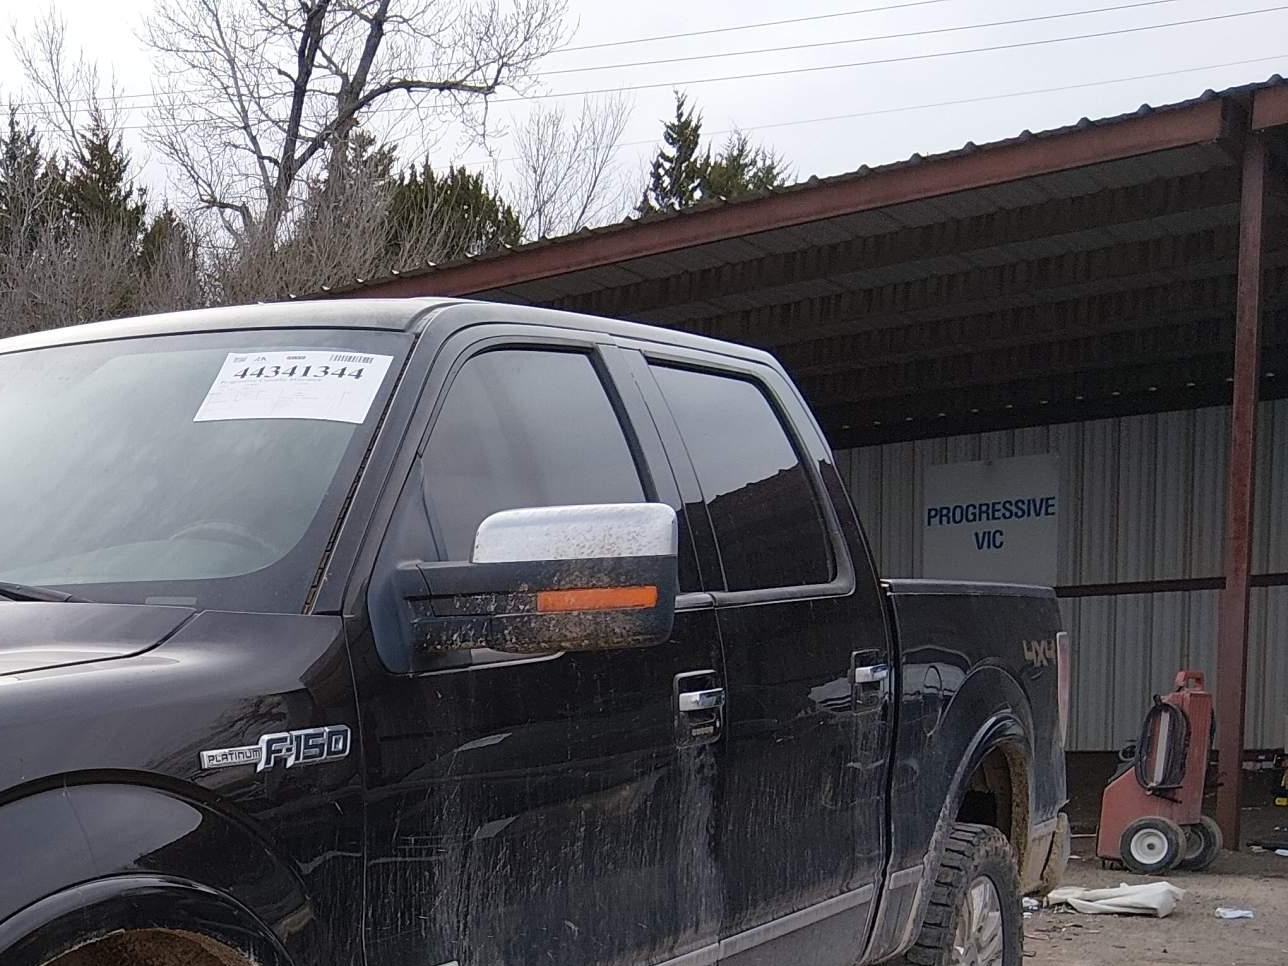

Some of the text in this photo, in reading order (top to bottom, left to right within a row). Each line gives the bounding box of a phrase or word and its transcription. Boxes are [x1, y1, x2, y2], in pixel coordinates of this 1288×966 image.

[234, 365, 365, 380] 44341344
[927, 496, 1056, 527] PROGRESSIVE
[974, 529, 1004, 551] VIC
[207, 748, 261, 764] PLATINUM
